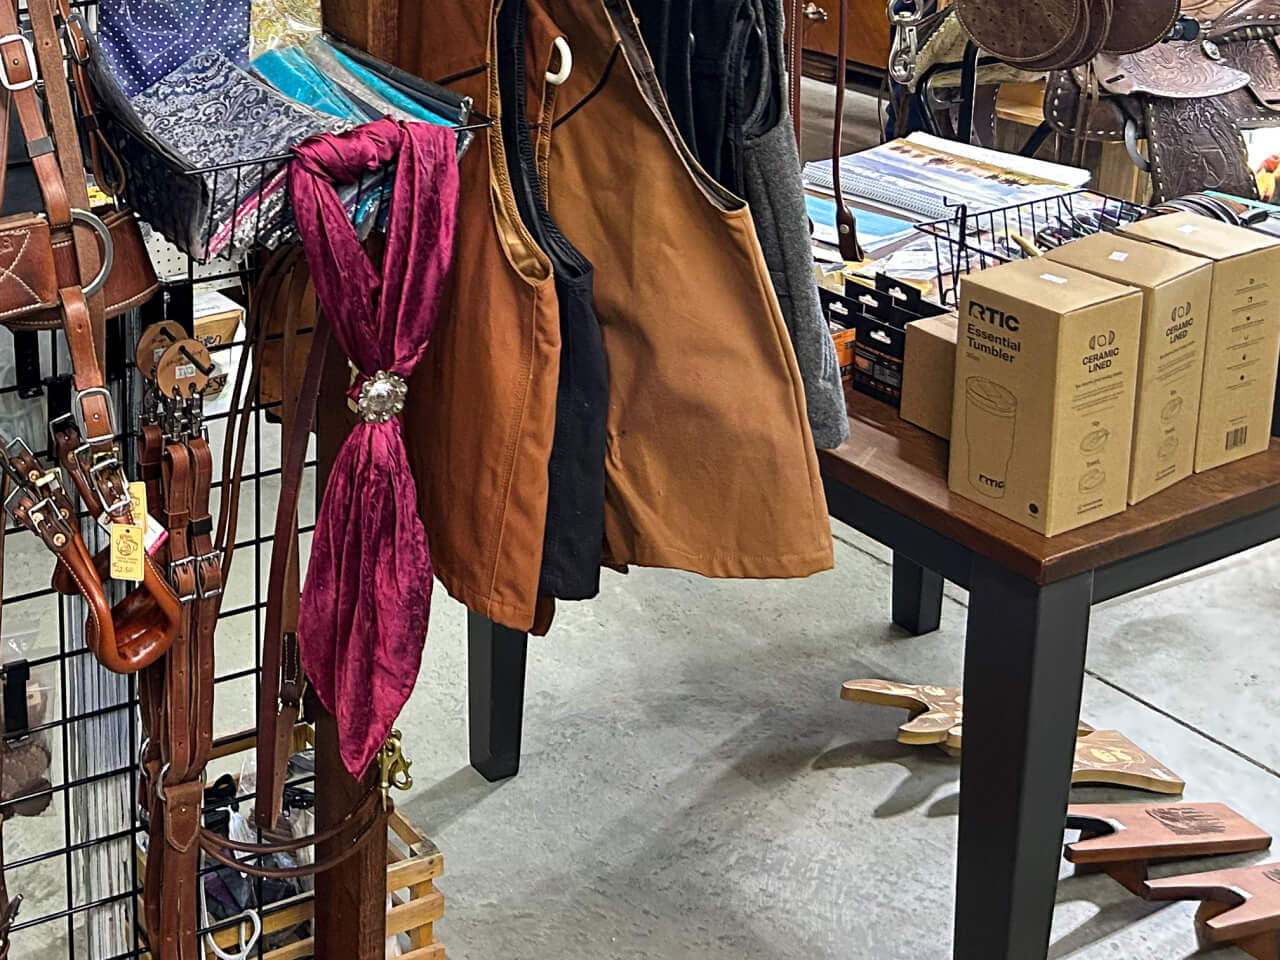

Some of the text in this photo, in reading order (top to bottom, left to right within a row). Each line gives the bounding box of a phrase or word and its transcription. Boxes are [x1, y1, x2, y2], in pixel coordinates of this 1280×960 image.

[968, 301, 1020, 332] RTIC
[967, 323, 1021, 353] Essential
[967, 336, 1015, 363] Tumbler
[1082, 347, 1120, 366] CERAMIC
[1088, 359, 1112, 374] LINED
